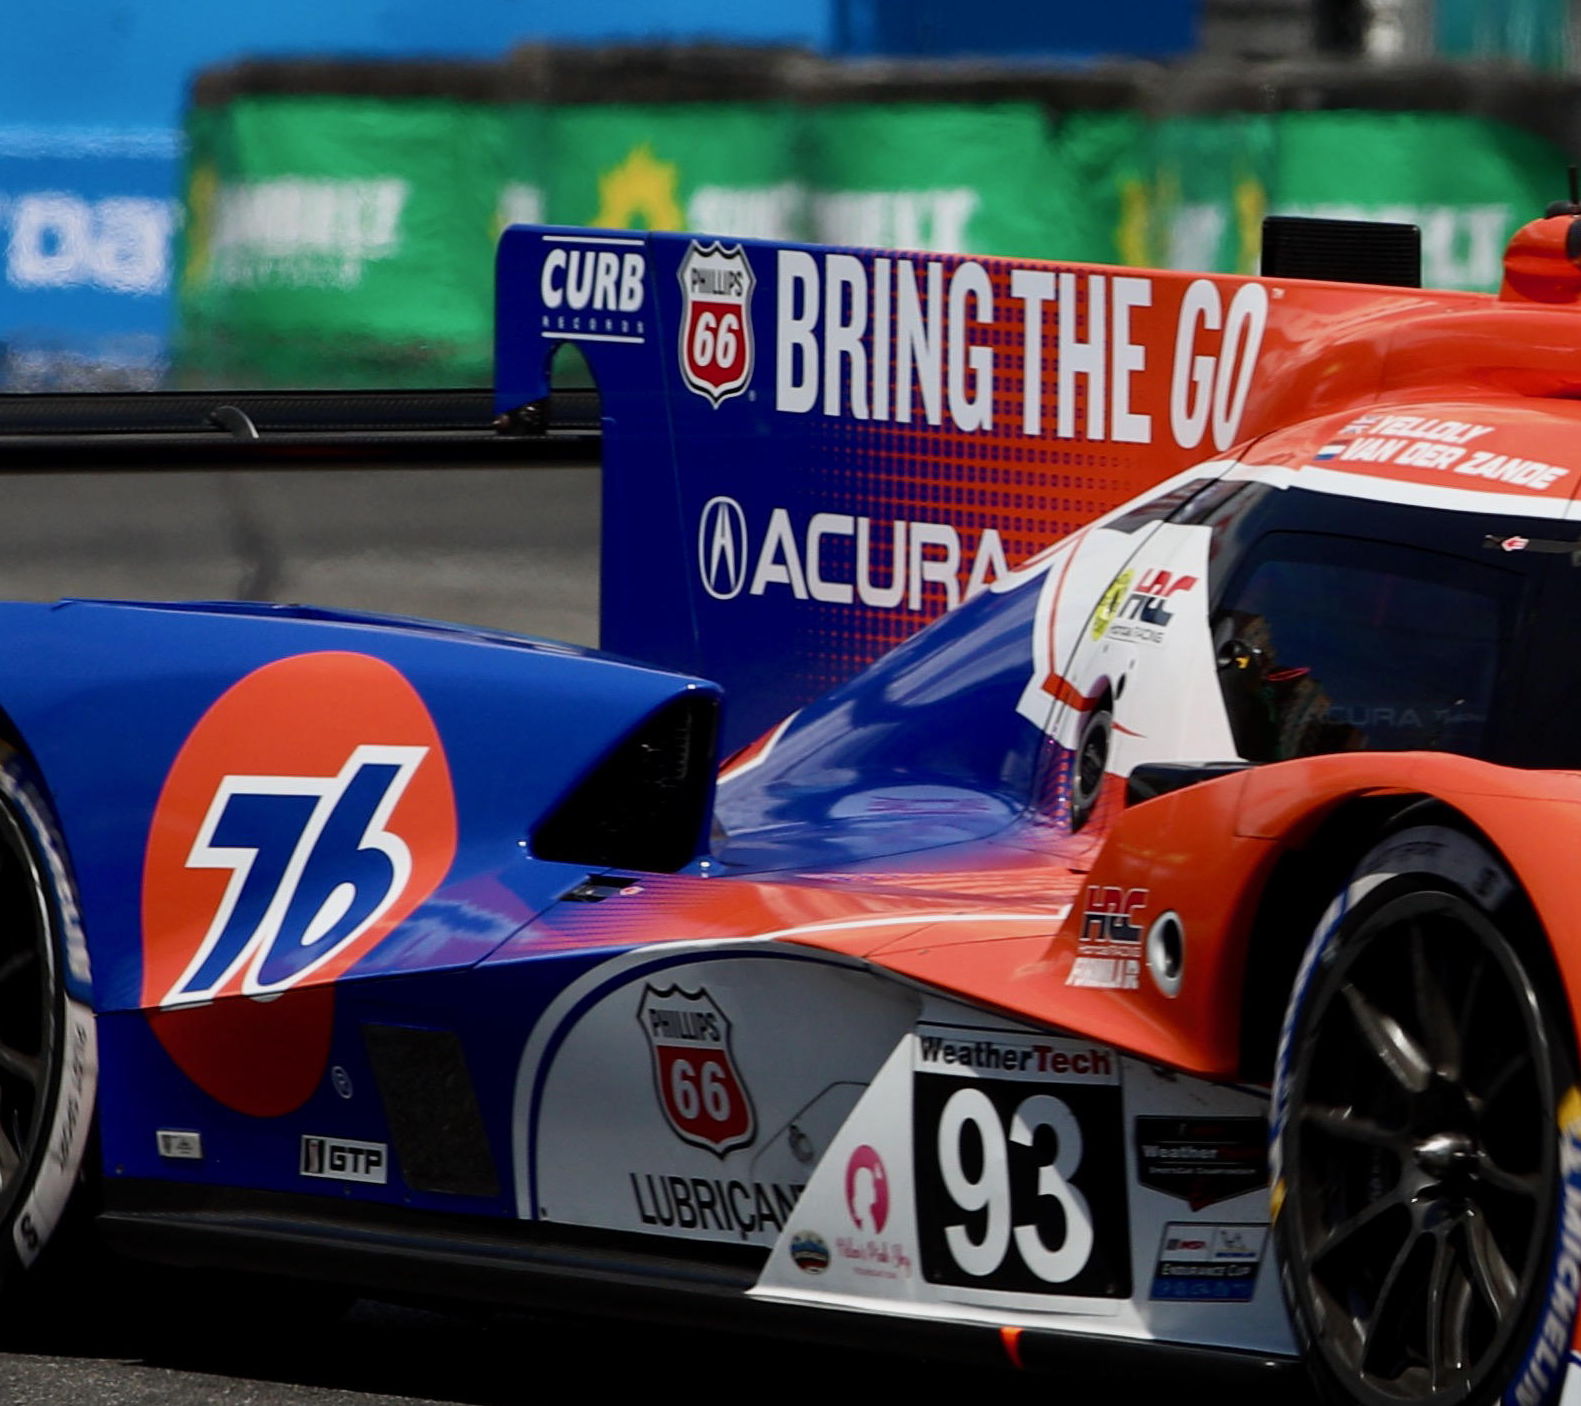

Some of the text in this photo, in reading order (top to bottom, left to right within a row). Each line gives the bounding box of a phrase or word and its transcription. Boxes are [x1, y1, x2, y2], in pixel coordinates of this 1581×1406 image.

[541, 248, 646, 313] CURB
[691, 267, 743, 298] PHILLIPS
[692, 311, 740, 369] 66
[777, 250, 1268, 451] BRING THE GO
[1370, 415, 1495, 444] YELLOLY
[1340, 437, 1570, 490] VAN DER ZANDE
[750, 507, 1008, 612] ACURA
[160, 745, 429, 1011] 76
[649, 1008, 721, 1042] PHILLIPS
[920, 1035, 1112, 1076] WeatherTech
[671, 1058, 732, 1122] 66
[329, 1144, 382, 1175] GTP
[937, 1088, 1095, 1284] 93
[629, 1172, 807, 1233] LUBRICAN
